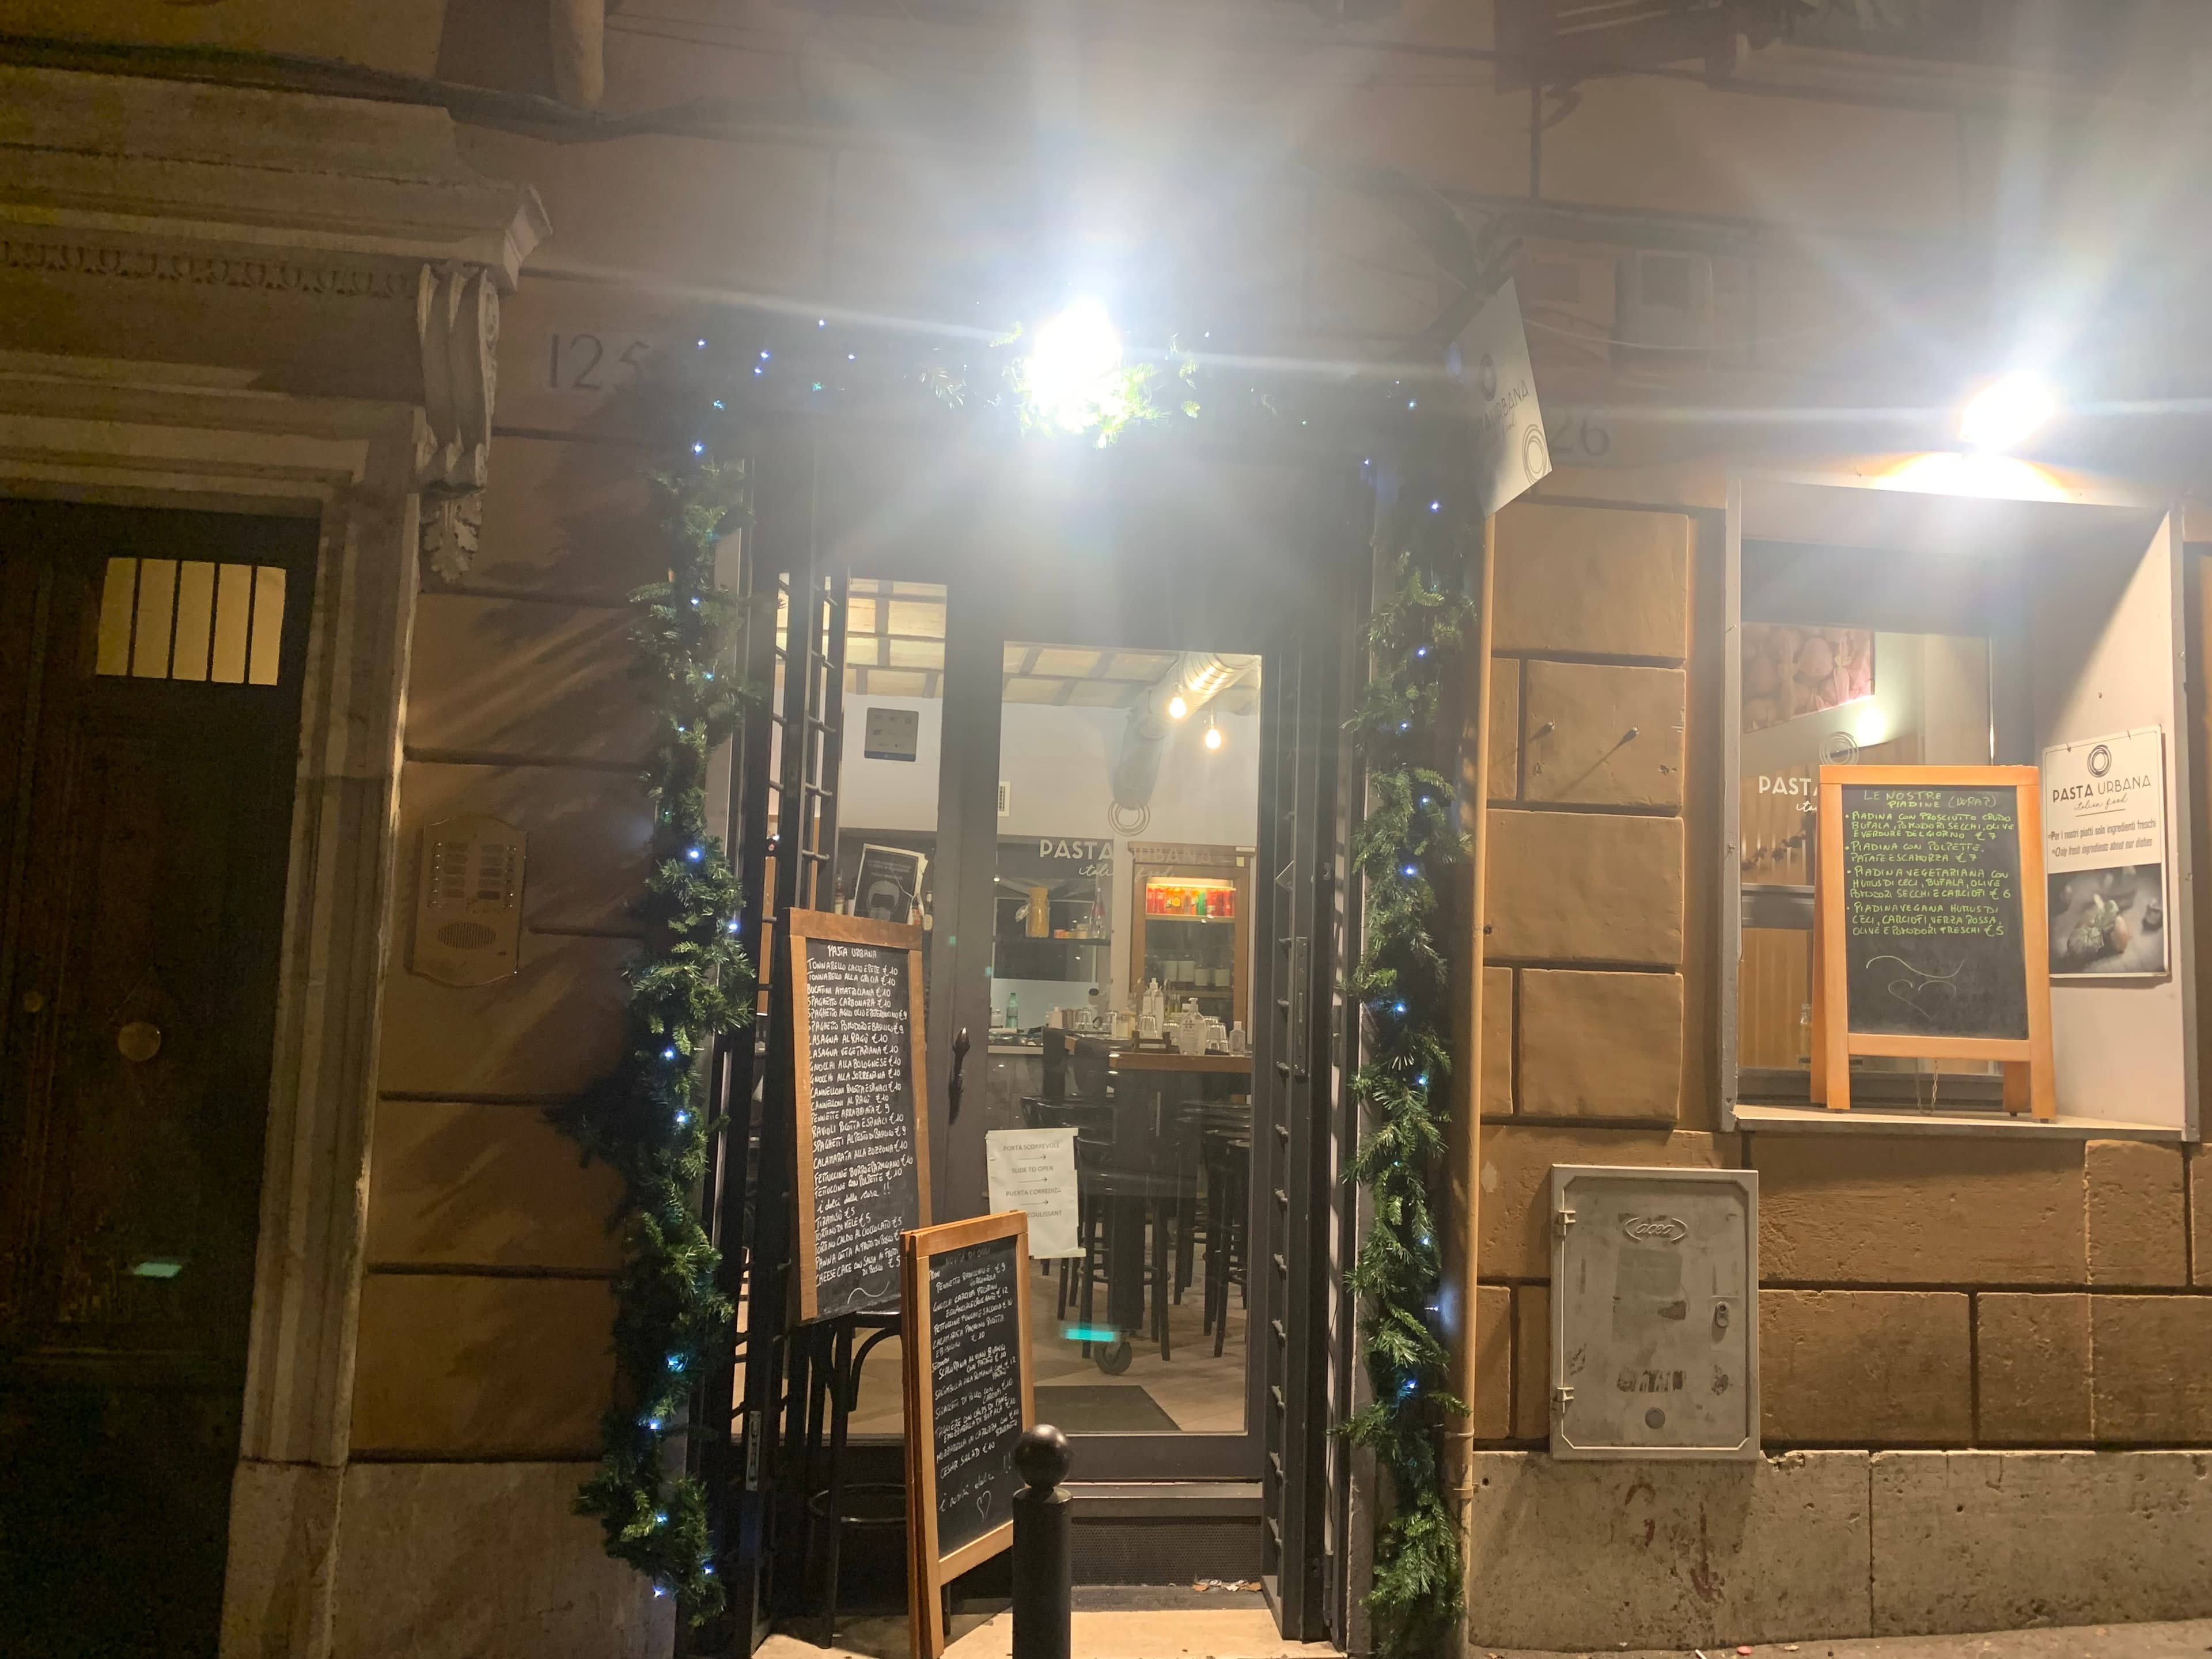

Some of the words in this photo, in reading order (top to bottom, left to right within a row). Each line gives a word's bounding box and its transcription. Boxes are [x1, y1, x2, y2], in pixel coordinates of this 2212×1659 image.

[2052, 784, 2093, 802] PASTA
[2098, 775, 2151, 794] URBANA
[1864, 790, 1880, 800] LE
[1886, 791, 1942, 800] NOSTRE
[1887, 800, 1941, 808] PIADINE
[1853, 811, 1892, 820] PIADINA
[1919, 812, 1976, 821] PROSCIUTTO
[1982, 813, 2010, 821] CRUDO
[2107, 821, 2135, 835] ingredienti
[2138, 818, 2156, 829] freschi
[1861, 830, 1901, 838] VERDURE
[1040, 839, 1113, 861] PASTA
[1851, 840, 1898, 852] PIADINA
[1851, 852, 1885, 862] PATATE
[1854, 865, 1903, 877] PIADINA
[1906, 869, 1984, 878] VEGETARIANA
[1991, 870, 2008, 878] CON
[1896, 888, 1930, 898] SECCHI
[2003, 889, 2010, 898] 6
[1854, 902, 1898, 913] PIADINA
[1900, 904, 1944, 912] VEGANA
[1853, 927, 1880, 935] OLIVE
[1995, 926, 2003, 935] 5
[827, 945, 847, 957] PASTA
[851, 948, 877, 958] URBANA
[1024, 1142, 1060, 1150] SCORREVOLE
